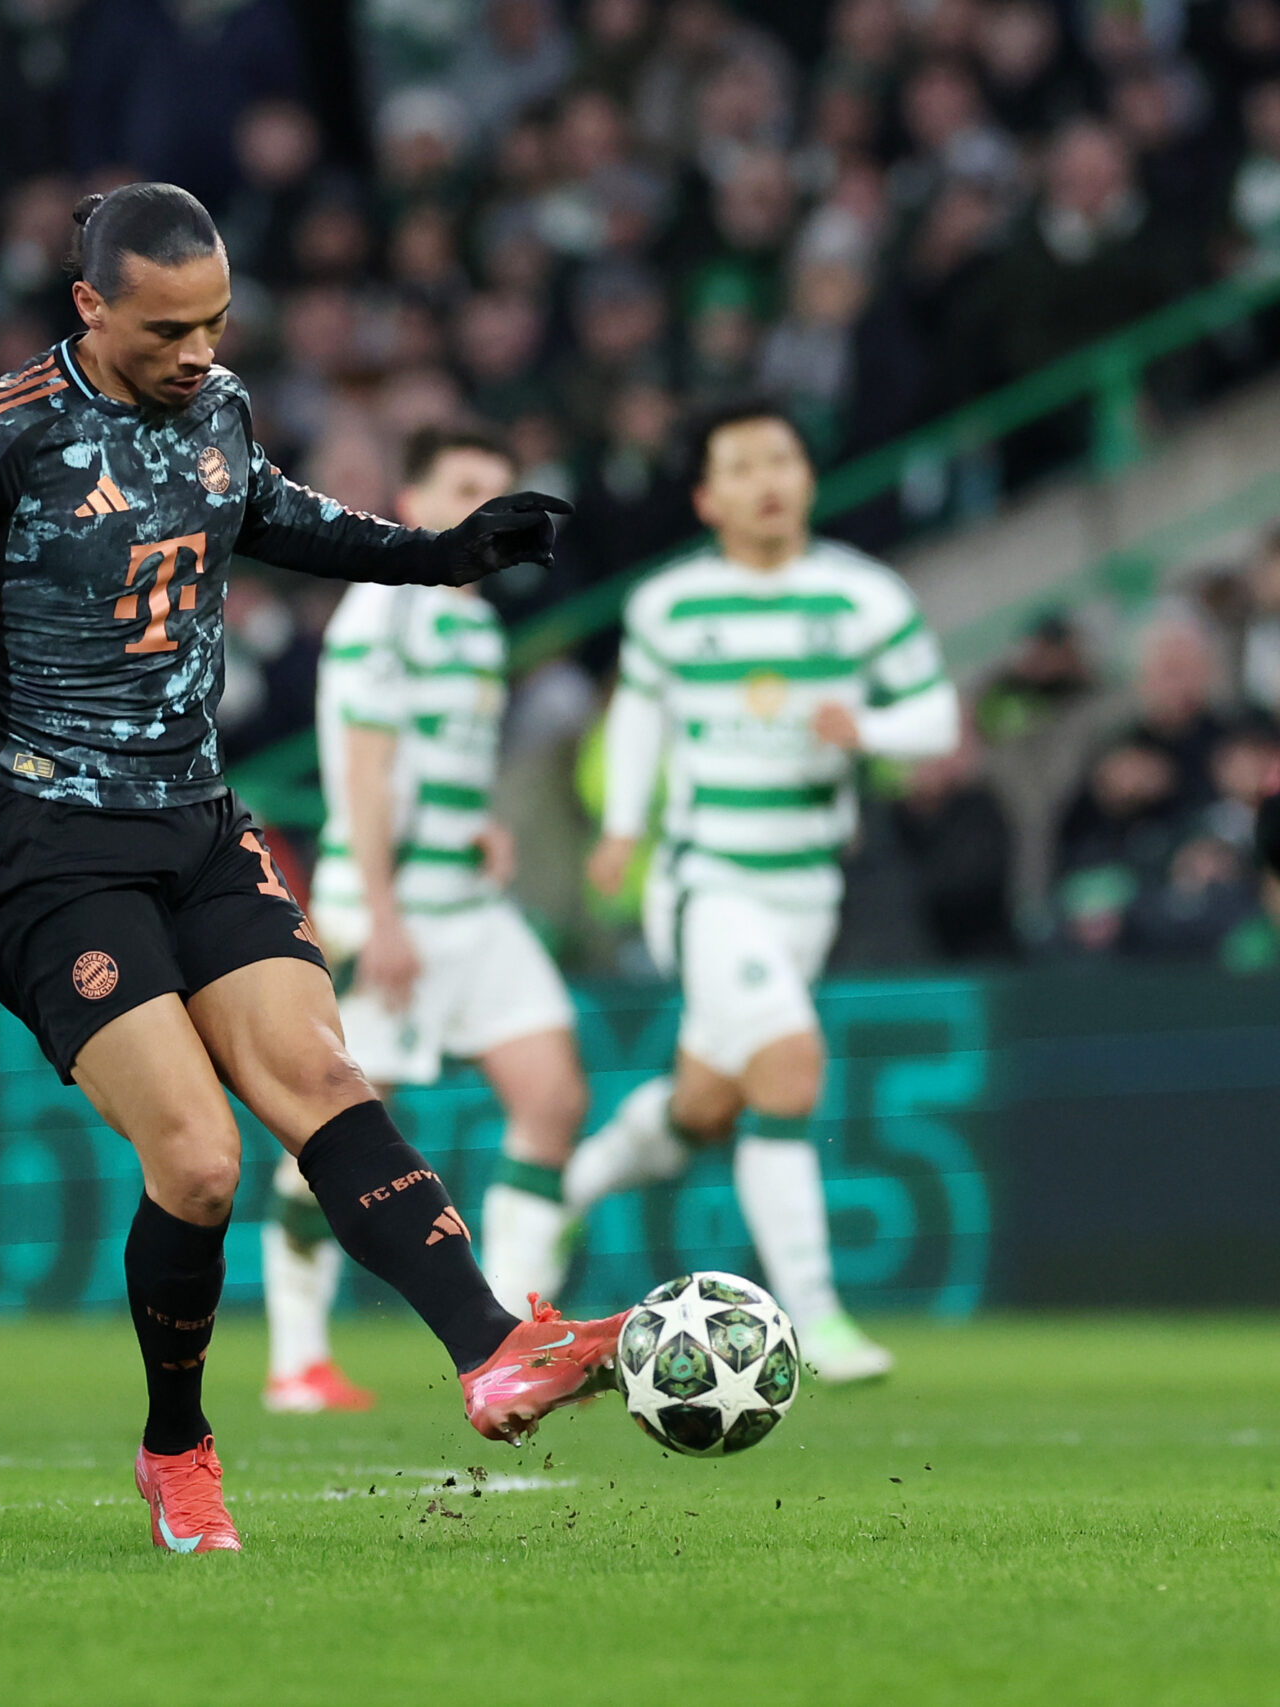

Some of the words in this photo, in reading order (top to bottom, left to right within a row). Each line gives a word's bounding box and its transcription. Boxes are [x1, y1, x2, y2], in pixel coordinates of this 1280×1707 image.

[114, 532, 207, 653] T
[77, 953, 110, 968] BAYERN
[359, 1186, 391, 1209] FC
